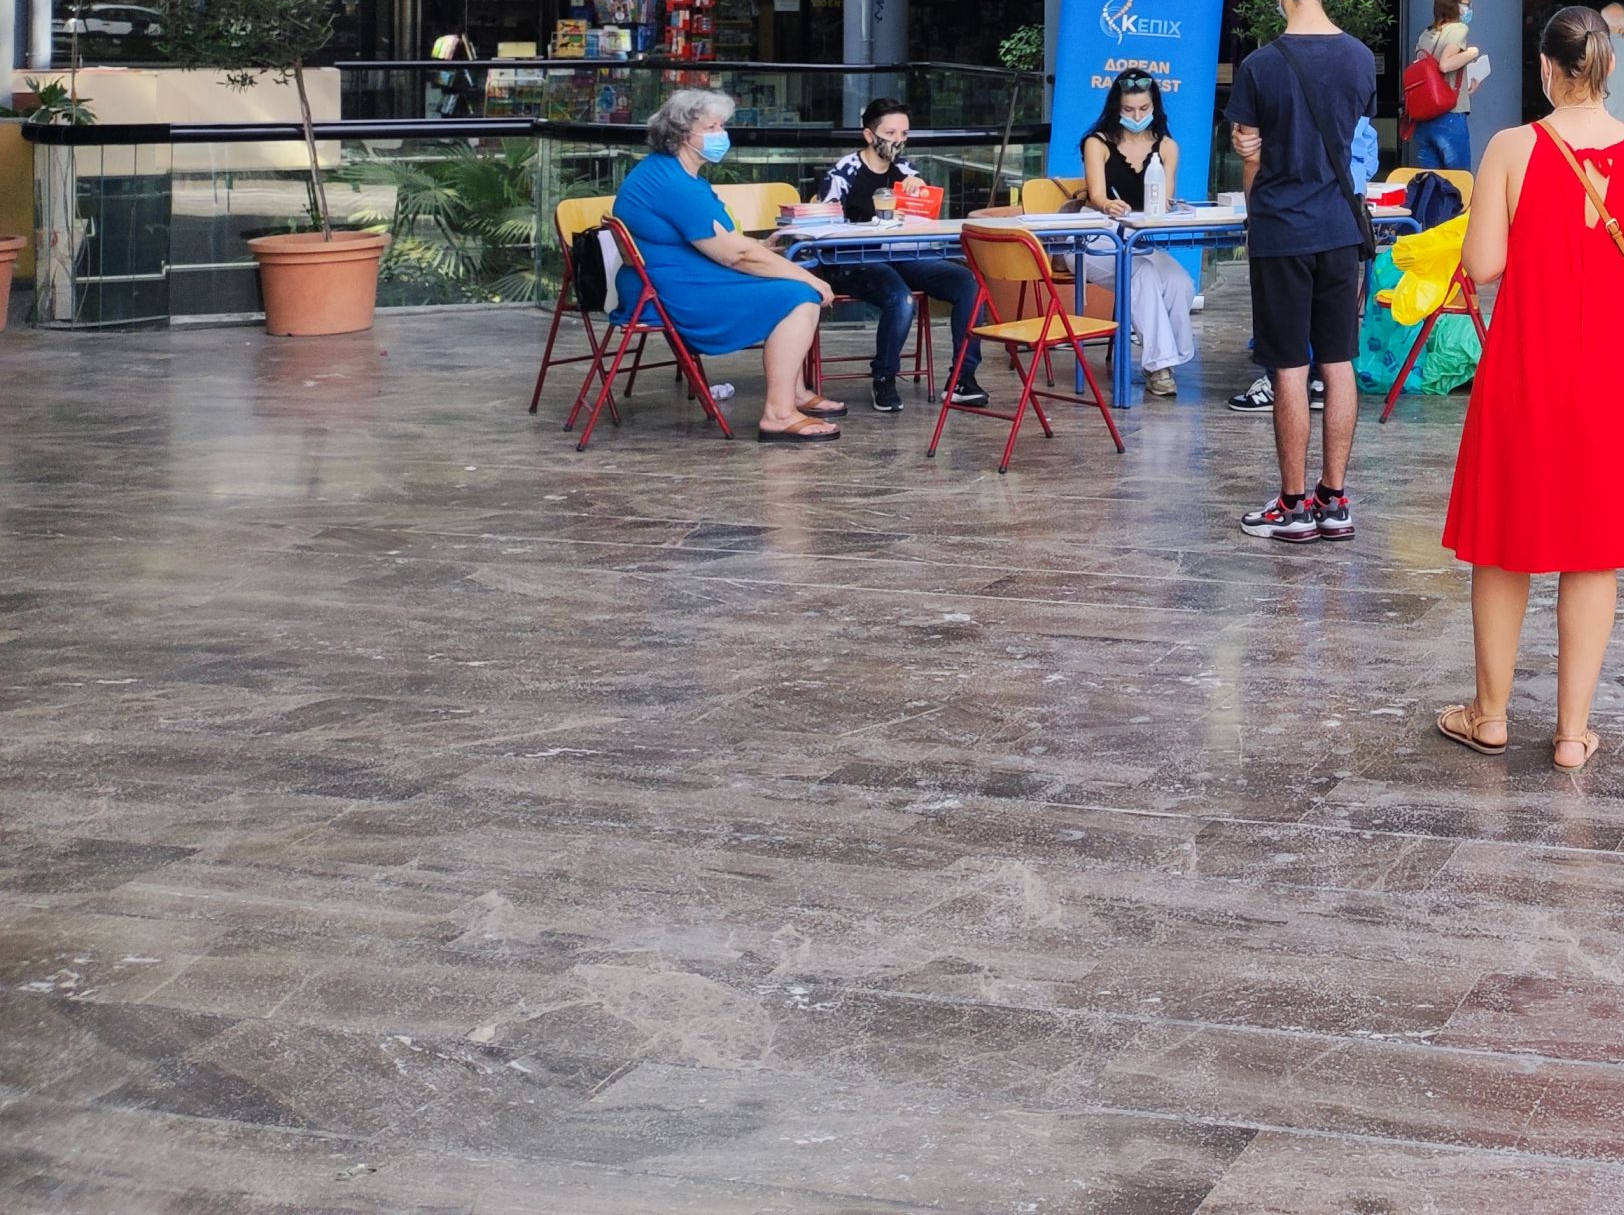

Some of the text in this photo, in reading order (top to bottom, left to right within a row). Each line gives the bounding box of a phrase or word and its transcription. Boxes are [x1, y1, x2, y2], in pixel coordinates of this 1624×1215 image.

[1104, 58, 1170, 74] ΔΩΡΕΑΝ
[1156, 78, 1182, 93] EST
[1252, 391, 1269, 405] N
